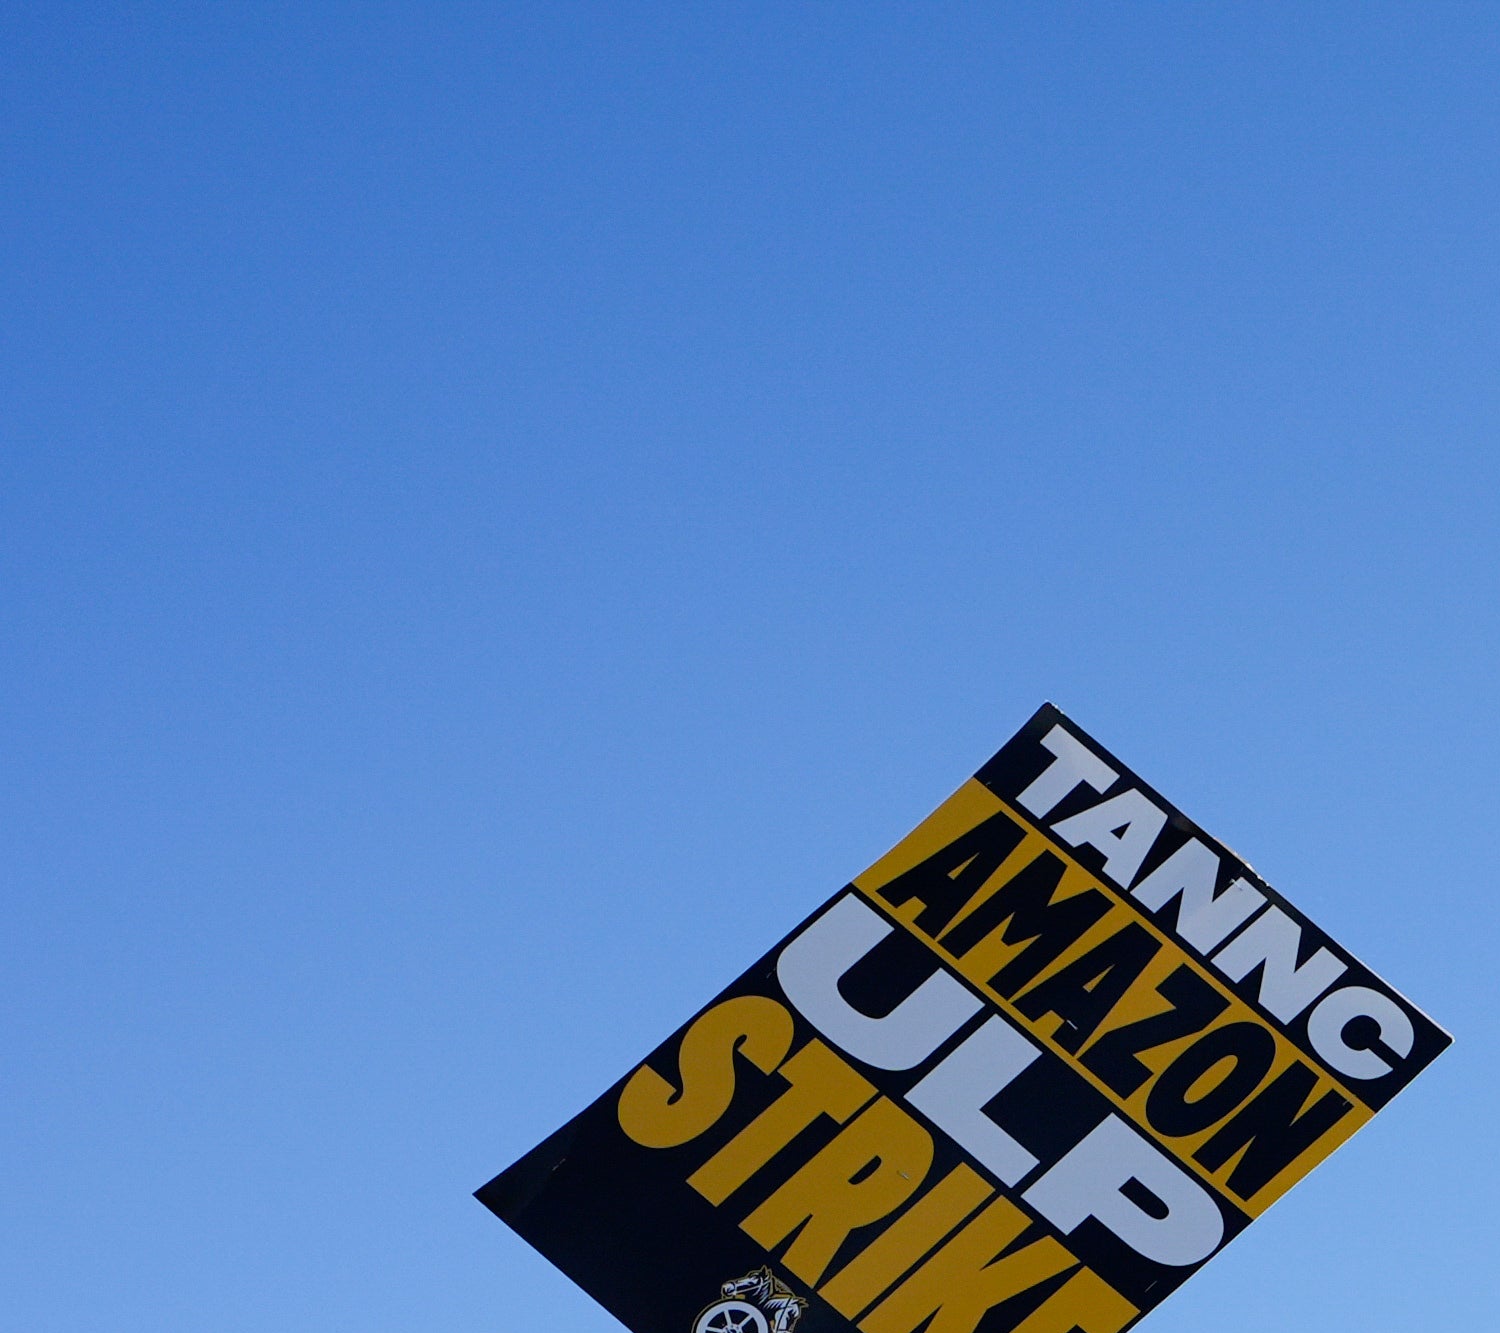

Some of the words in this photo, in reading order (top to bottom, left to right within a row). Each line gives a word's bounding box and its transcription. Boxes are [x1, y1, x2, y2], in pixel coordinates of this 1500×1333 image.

[776, 892, 1223, 1266] ULP
[876, 810, 1354, 1201] AMAZON
[1014, 723, 1414, 1079] TANNC
